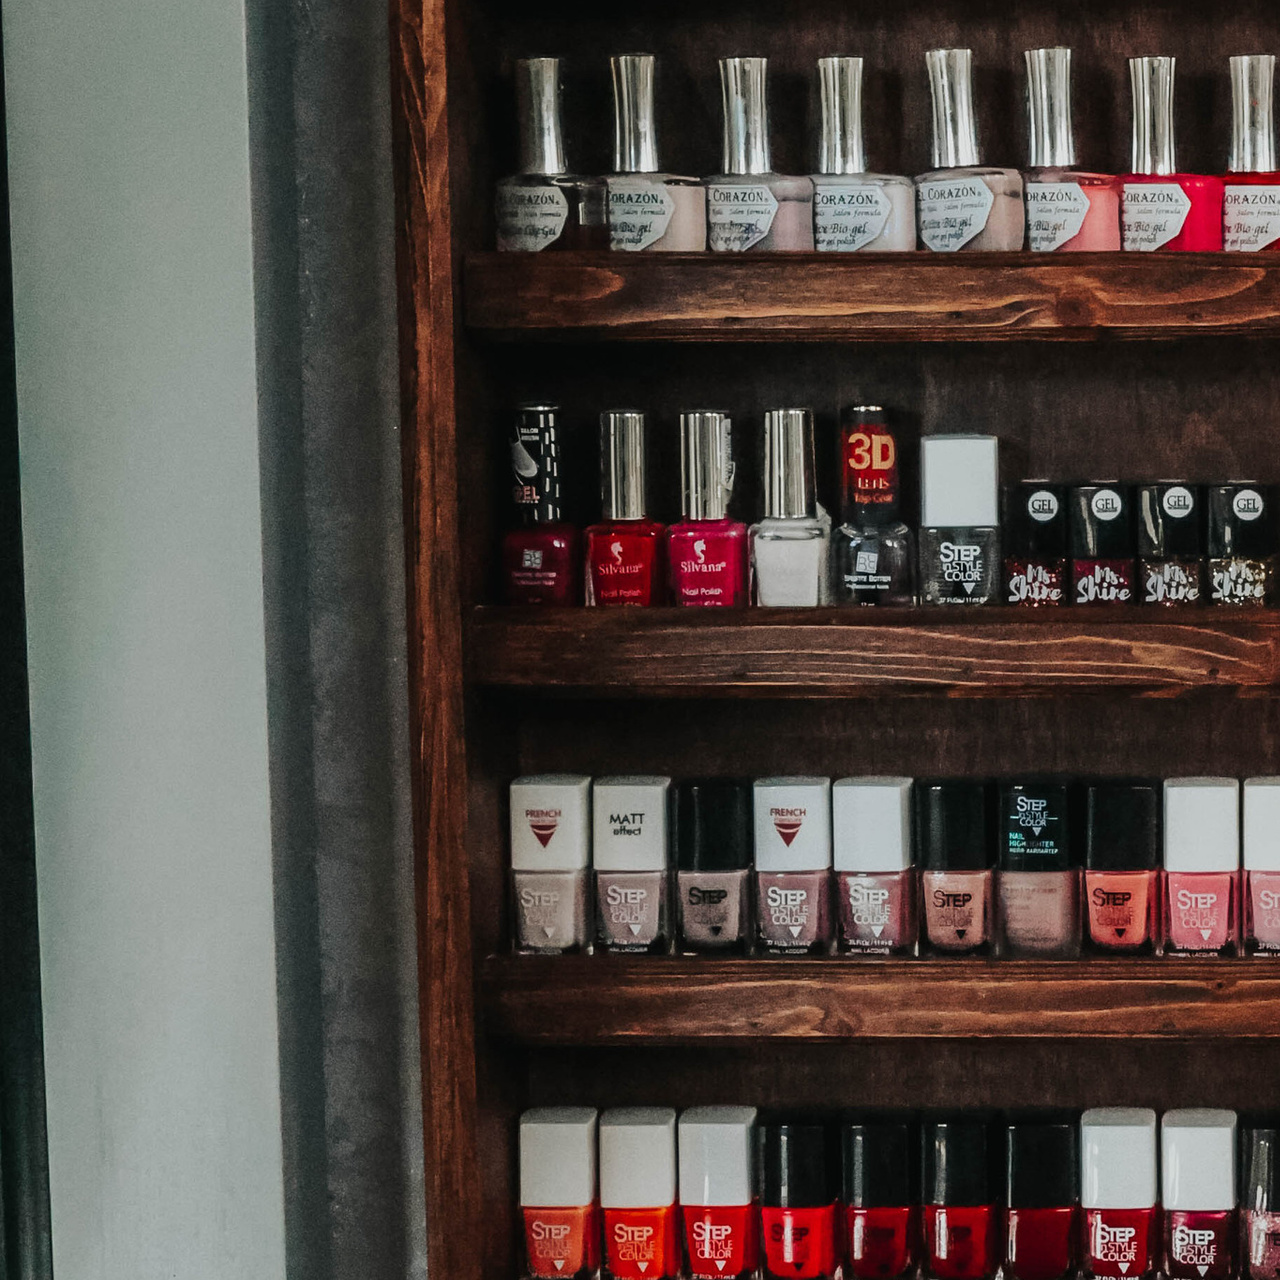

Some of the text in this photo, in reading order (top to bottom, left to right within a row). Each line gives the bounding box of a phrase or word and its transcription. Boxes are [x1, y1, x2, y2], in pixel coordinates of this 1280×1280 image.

[713, 188, 763, 202] CORAZÓN
[928, 184, 976, 200] CORAZÓN
[1026, 189, 1072, 202] ORAZÓN
[1226, 191, 1276, 205] ORAZÓN
[853, 209, 881, 218] formula
[848, 433, 895, 470] 3D
[1031, 499, 1054, 511] GEL
[1095, 498, 1117, 510] GEL
[1167, 496, 1189, 508] GEL
[1237, 499, 1259, 511] GEL
[940, 542, 981, 562] STEP
[680, 561, 722, 573] Silvana
[945, 570, 981, 581] COLOR
[1077, 575, 1131, 603] Shine
[1145, 575, 1200, 602] Shine
[1016, 796, 1047, 812] STEP
[609, 813, 645, 824] MATT
[770, 808, 806, 817] FRENCH
[1019, 818, 1047, 827] COLOR
[613, 826, 642, 836] effect
[1009, 832, 1025, 840] NAIL
[607, 885, 647, 906] STEP
[767, 887, 807, 907] STEP
[933, 890, 972, 908] STEP
[1092, 888, 1131, 907] STEP
[1177, 890, 1217, 910] STEP
[772, 914, 807, 925] COLOR
[853, 913, 890, 925] COLOR
[1182, 918, 1217, 929] COLOR
[532, 1221, 571, 1240] STEP
[614, 1224, 654, 1243] STEP
[693, 1222, 732, 1241] STEP
[1099, 1224, 1136, 1243] STEP
[1176, 1225, 1215, 1246] STEP
[619, 1250, 654, 1261] COLOR
[1101, 1251, 1136, 1261] COLOR
[1180, 1254, 1214, 1265] COLOR
